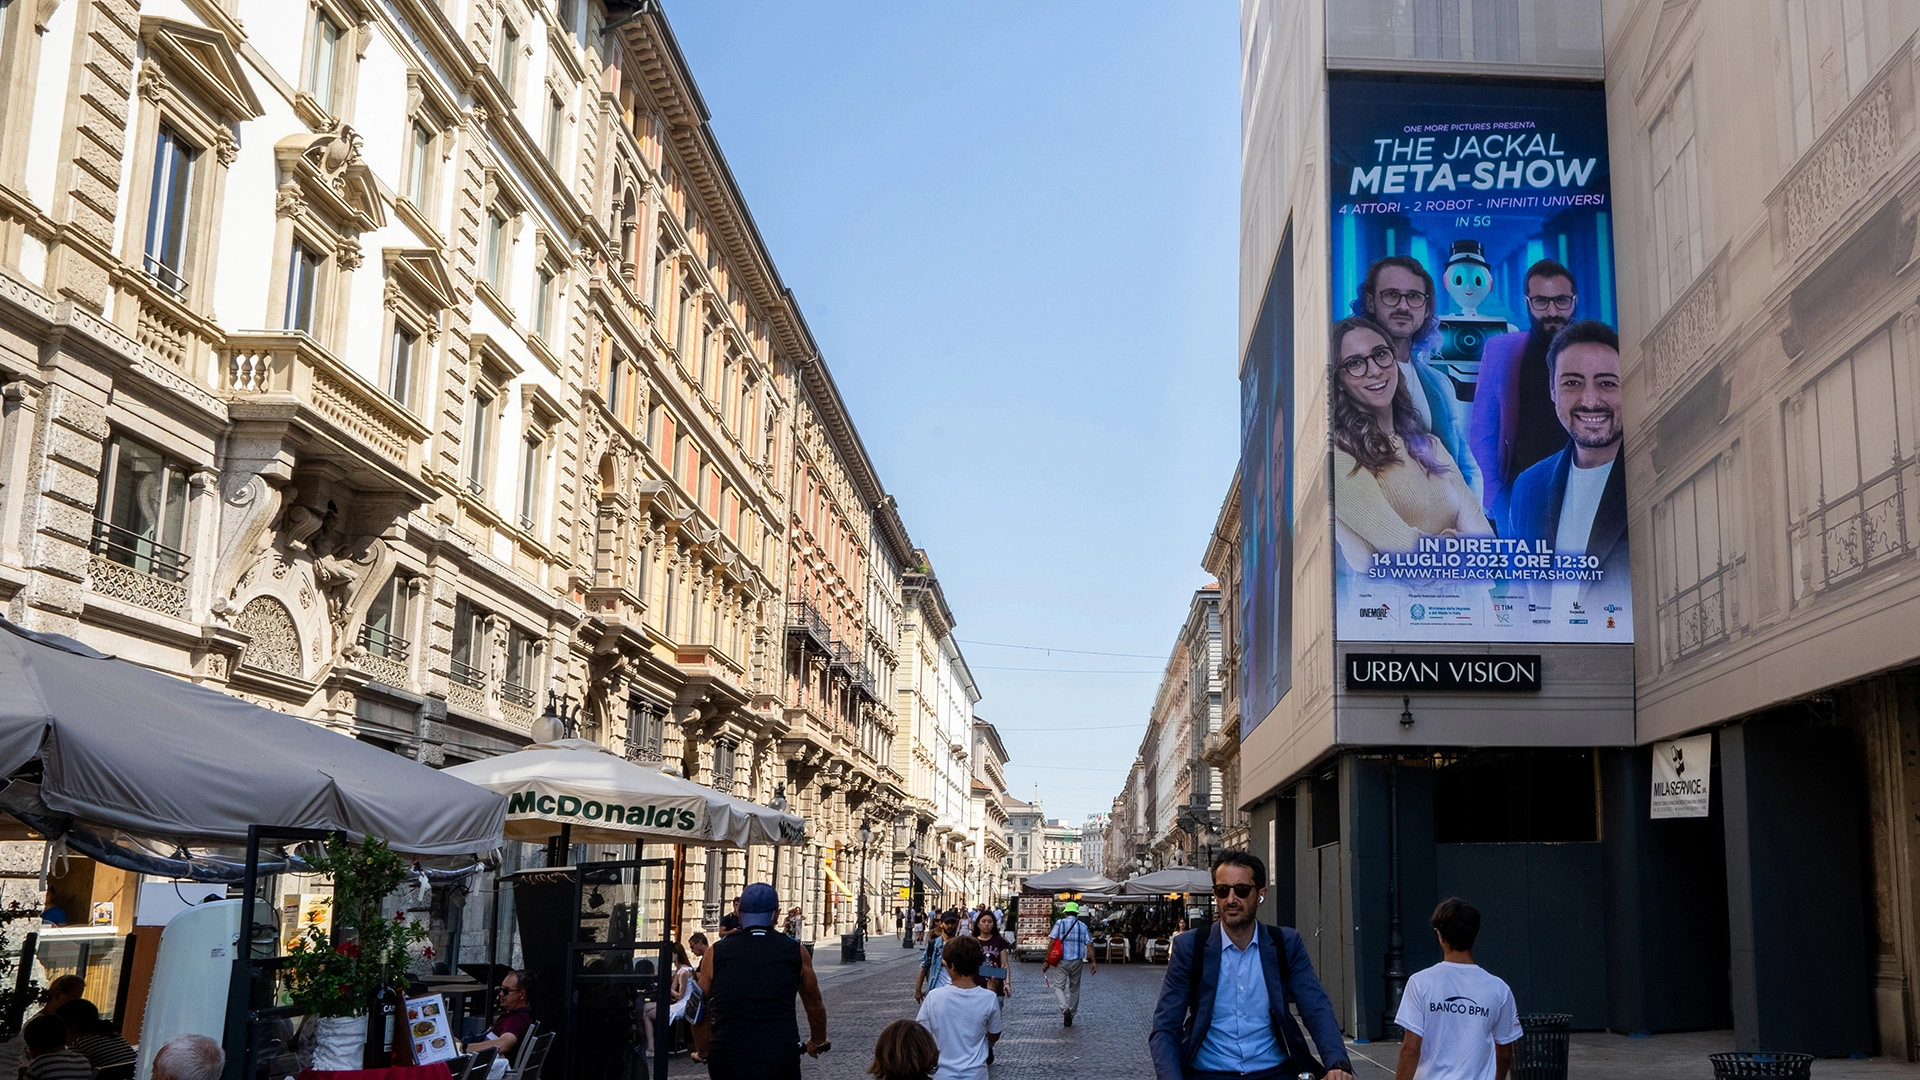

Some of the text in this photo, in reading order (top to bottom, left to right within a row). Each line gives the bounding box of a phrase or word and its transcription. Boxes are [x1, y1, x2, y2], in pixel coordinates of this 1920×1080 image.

[1403, 121, 1536, 133] ONE MORE PICTURES PRESENTA
[1374, 133, 1565, 162] THE JACKAL
[1349, 158, 1597, 195] META-SHOW
[1338, 204, 1347, 214] 4
[1351, 202, 1401, 215] ATTORI
[1413, 201, 1422, 212] 2
[1425, 199, 1474, 211] ROBOT
[1486, 196, 1539, 209] INFINITI
[1542, 193, 1605, 207] UNIVERSI
[1455, 215, 1491, 227] IN 5G
[1419, 538, 1553, 554] IN DIRETTA IL
[1372, 553, 1600, 569] 14 LUGLIO 2023 ORE 12:30
[1368, 568, 1604, 581] SU WWW.THEJACKALMETASHOW.IT
[1352, 661, 1535, 683] URBAN VISION
[507, 790, 696, 831] McDonald's
[1429, 1002, 1490, 1018] BANCO BPM
